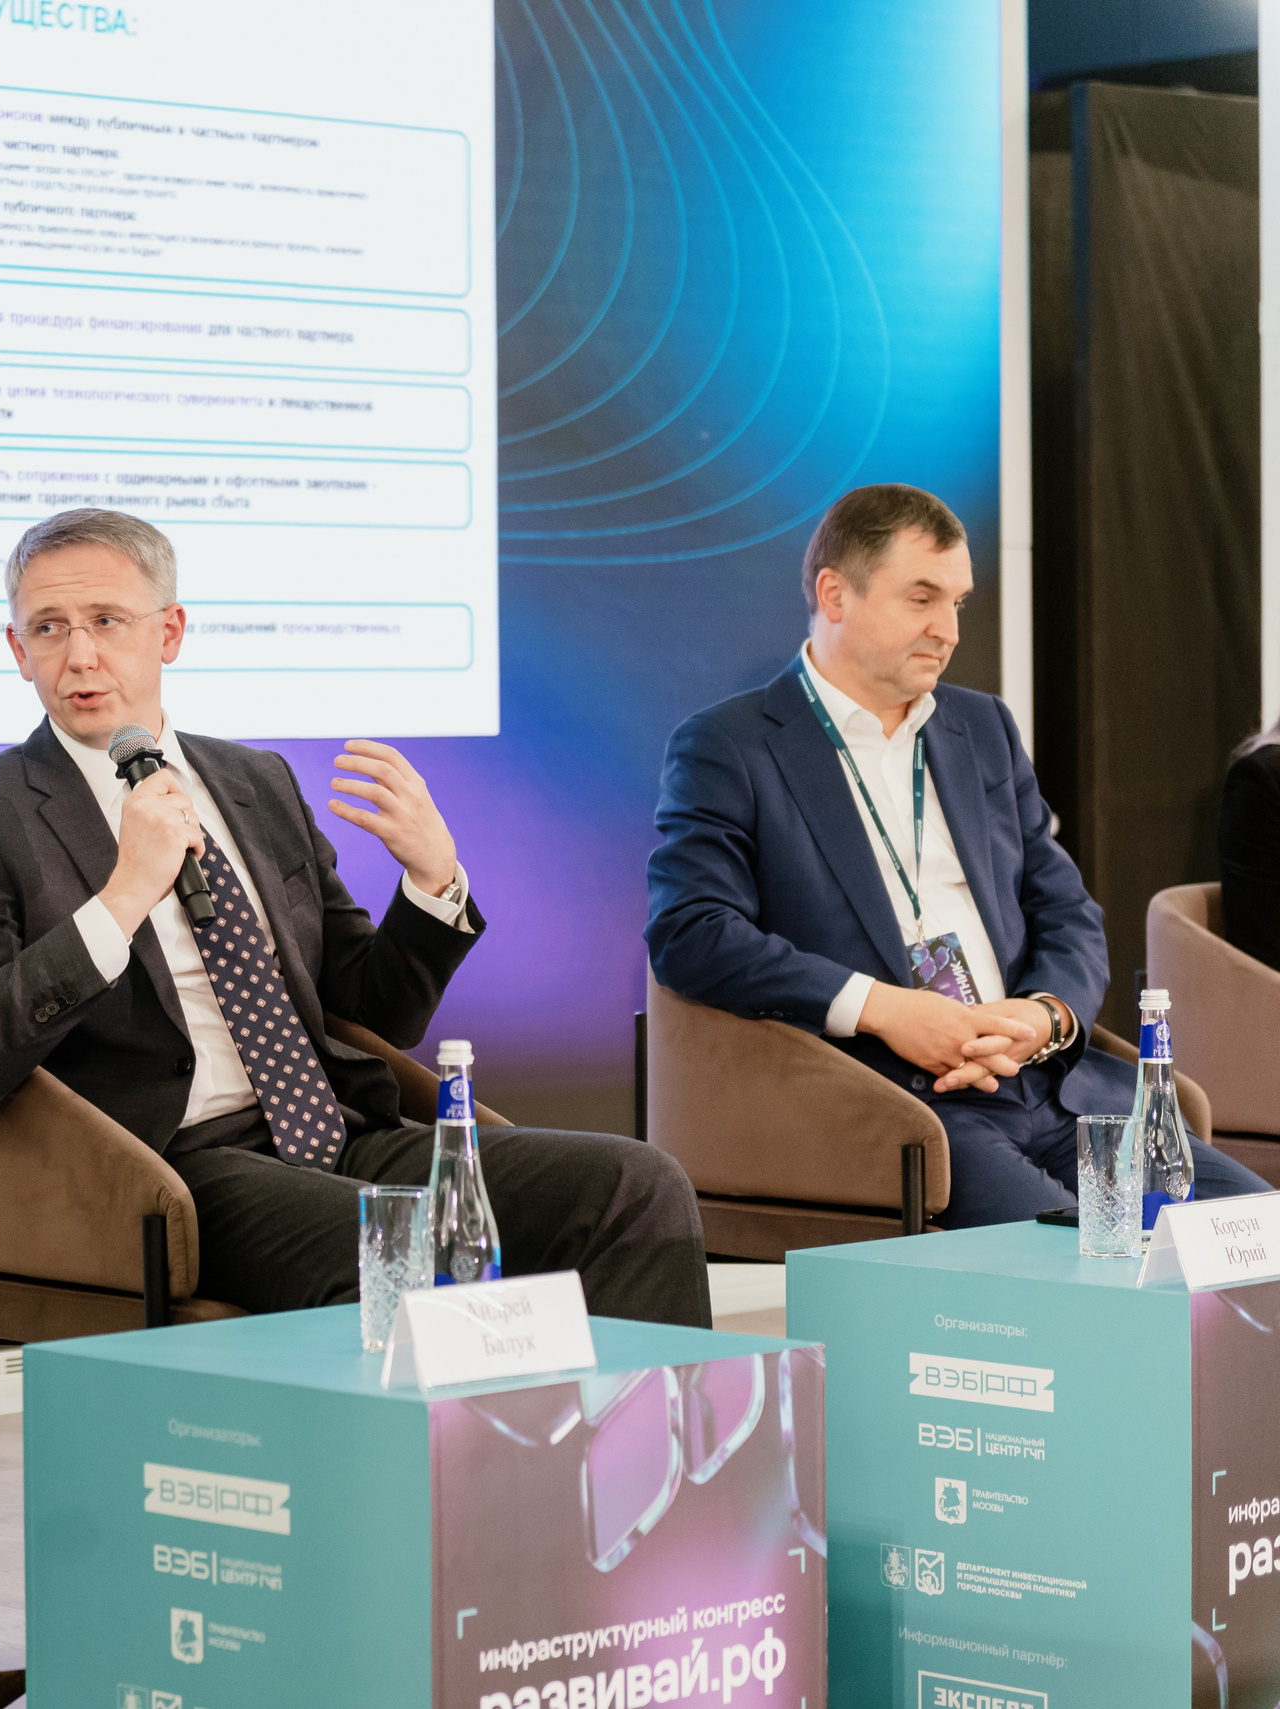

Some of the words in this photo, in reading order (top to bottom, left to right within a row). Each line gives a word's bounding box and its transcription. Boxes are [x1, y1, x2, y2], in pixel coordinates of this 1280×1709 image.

[950, 960, 977, 1007] СТНИК
[1210, 1217, 1260, 1238] Корсун
[1225, 1242, 1267, 1267] Юрий
[934, 1313, 1028, 1338] Организаторы:
[985, 1432, 1045, 1447] НАЦИОНАЛЬНЫЙ
[985, 1442, 1021, 1457] ЦЕНТР
[1023, 1447, 1045, 1461] ГЧП
[972, 1488, 1029, 1506] ПРАВИТЕЛЬСТВО
[972, 1501, 1004, 1513] МОСКВЫ
[1228, 1497, 1280, 1525] инфра
[956, 1561, 1011, 1578] ДЕПАРТАМЕНТ
[1012, 1571, 1087, 1590] ИНВЕСТИЦИОННОЙ
[956, 1572, 963, 1580] И
[964, 1573, 1032, 1591] ПРОМЫШЛЕННОЙ
[1033, 1584, 1076, 1599] ПОЛИТИКИ
[956, 1582, 987, 1595] ГОРОДА
[988, 1587, 1022, 1600] МОСКВЫ
[479, 1606, 688, 1673] инфраструктурный
[692, 1593, 786, 1632] конгресс
[898, 1626, 1010, 1658] Информационный
[1012, 1649, 1068, 1670] партнёр:
[934, 1687, 1034, 1709] ЭКСПЕ
